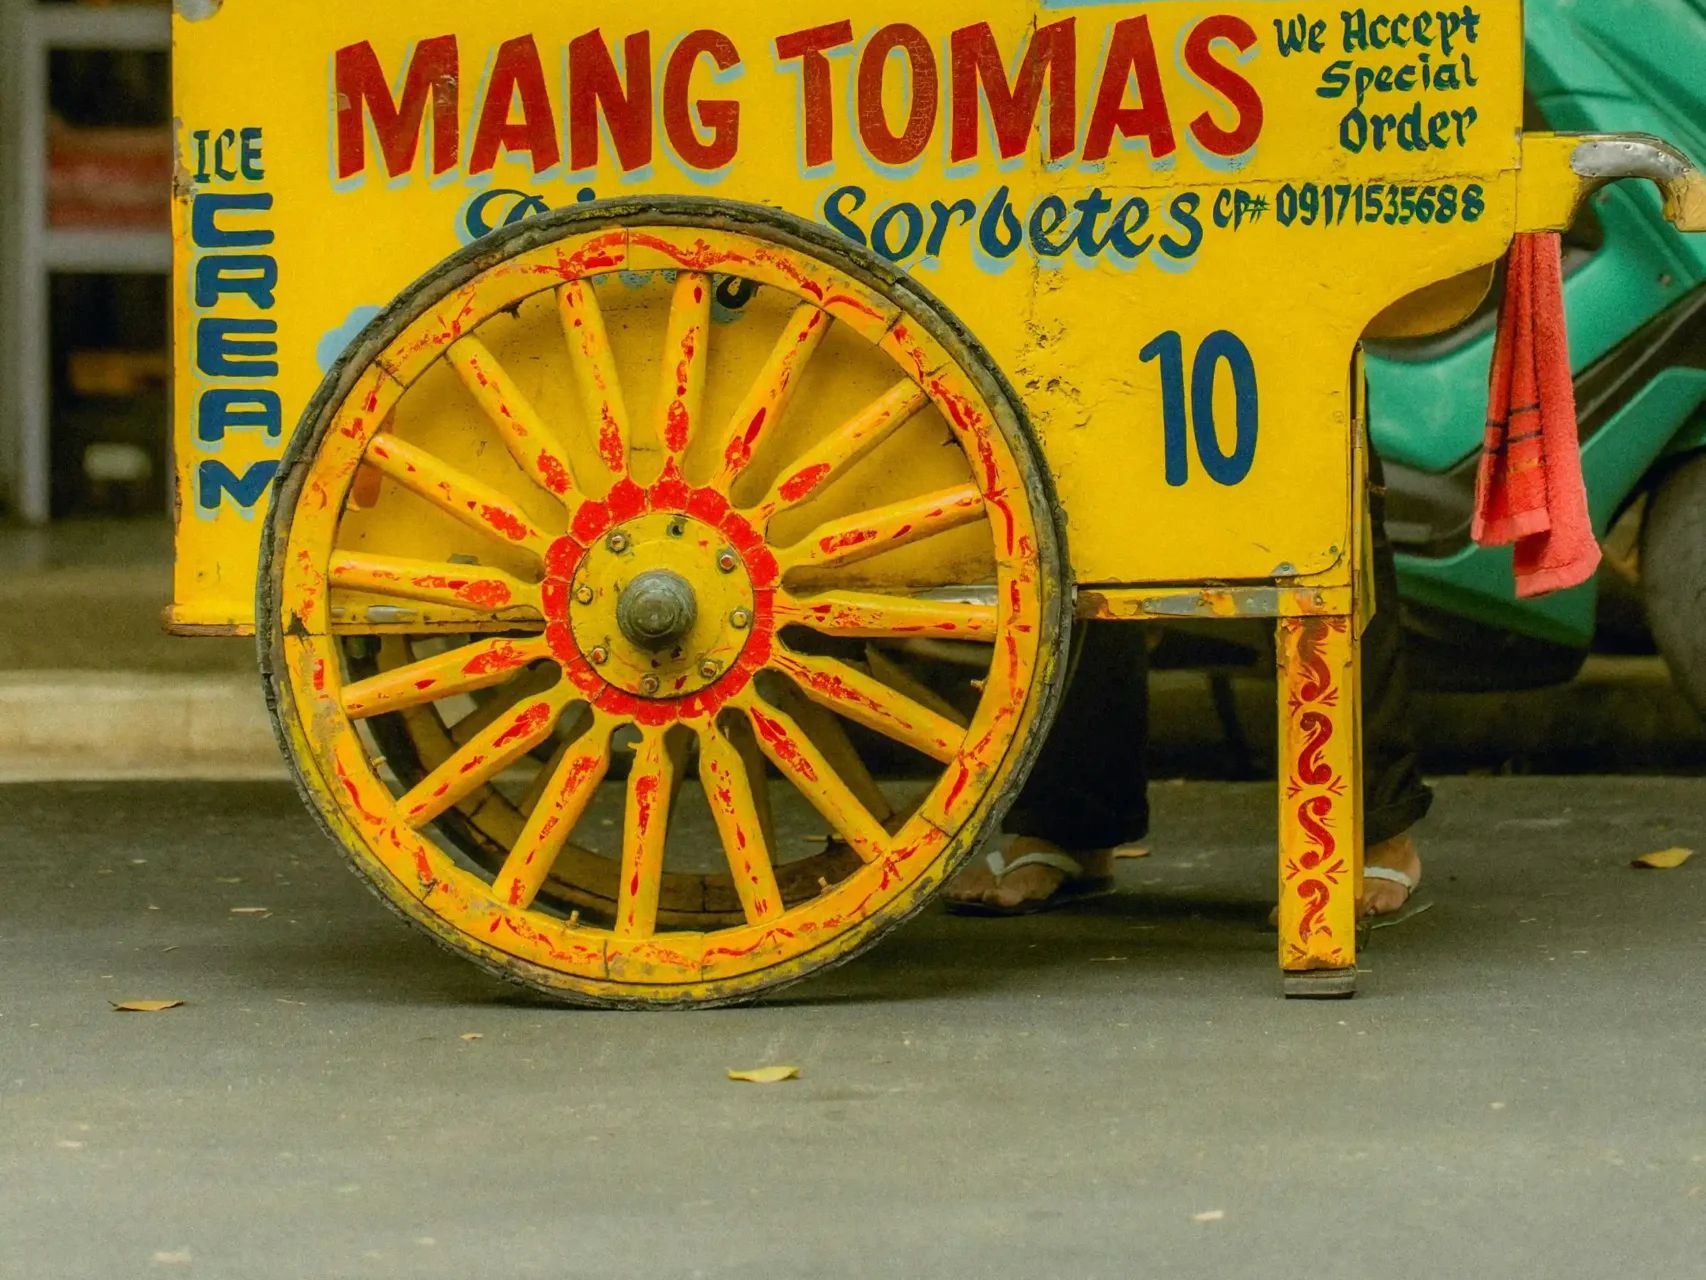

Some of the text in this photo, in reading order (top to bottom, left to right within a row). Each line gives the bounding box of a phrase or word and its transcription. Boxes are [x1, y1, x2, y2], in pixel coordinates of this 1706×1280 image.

[1273, 5, 1481, 58] We Accept
[336, 14, 1264, 179] MANG TOMAS
[1315, 53, 1479, 107] Special
[192, 127, 265, 183] ICE
[1338, 101, 1478, 153] Order
[823, 185, 1204, 261] Sorbetes
[1275, 182, 1485, 229] 09171535688
[191, 192, 282, 509] CREAM
[1138, 329, 1259, 487] 10
